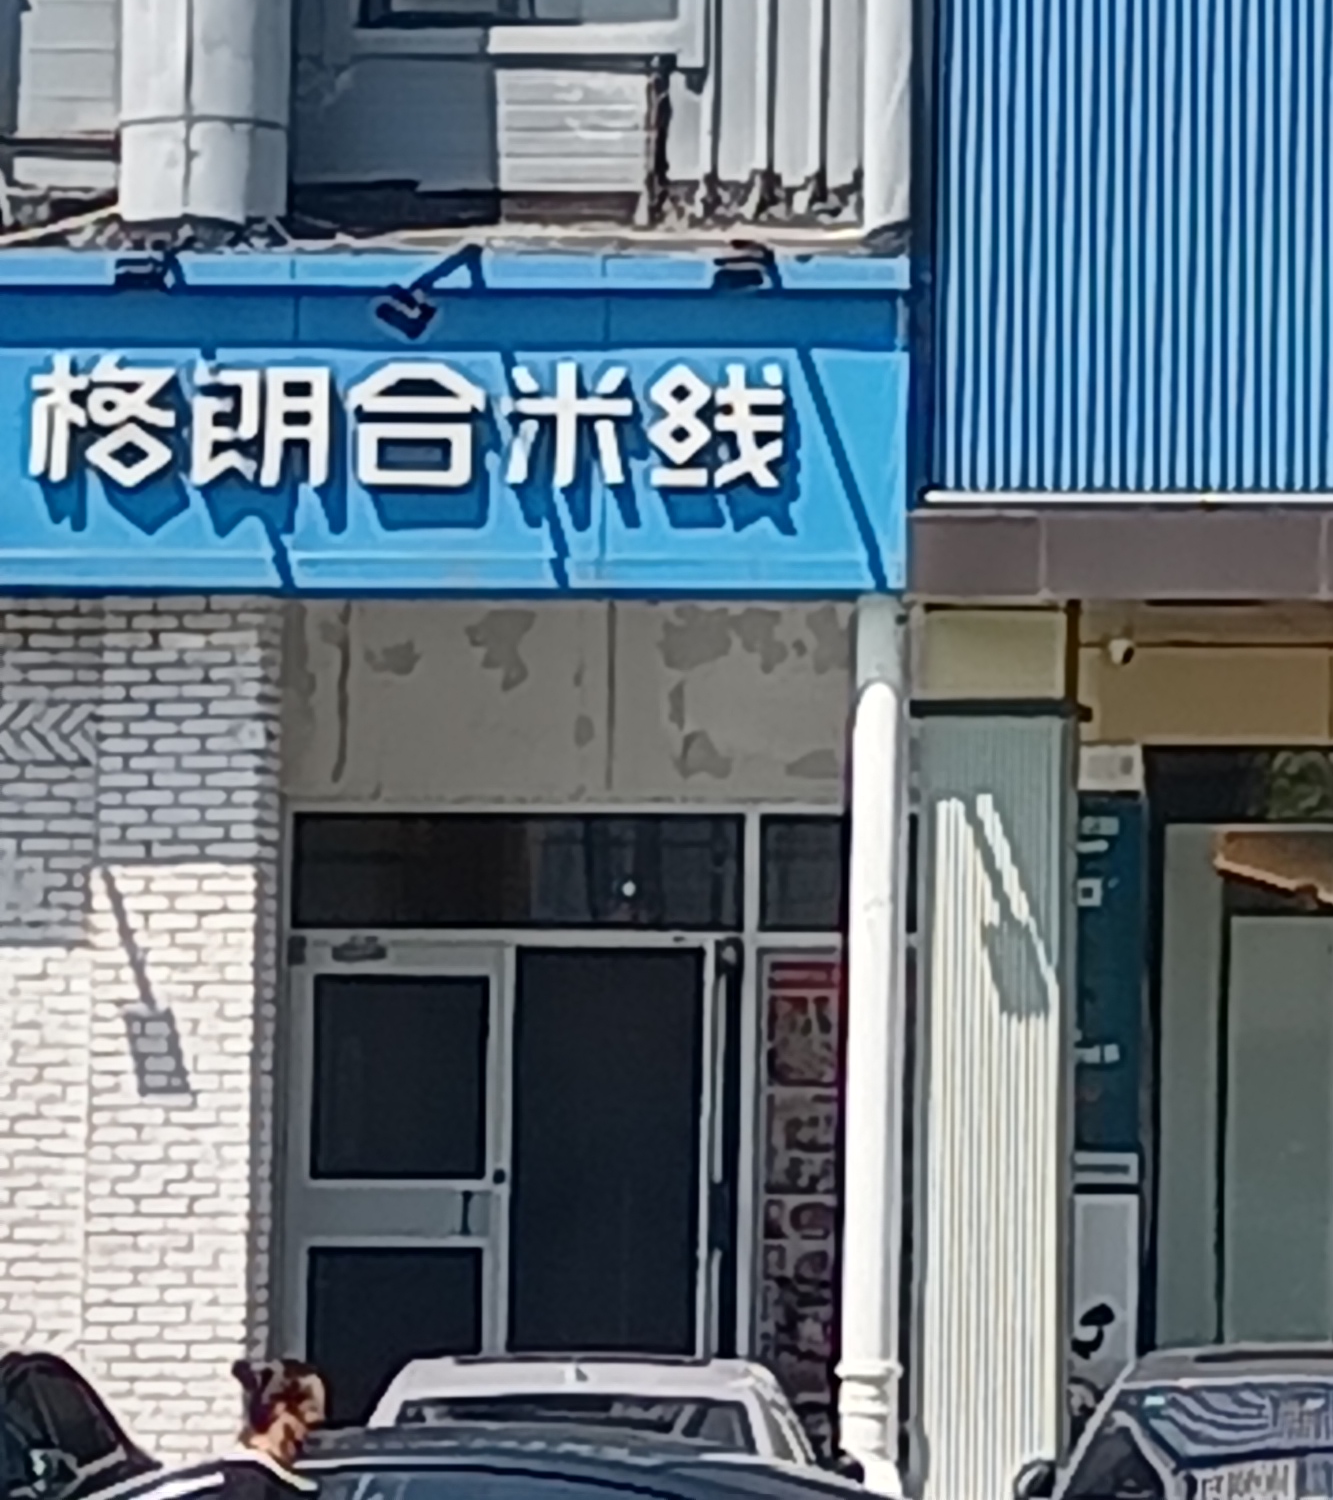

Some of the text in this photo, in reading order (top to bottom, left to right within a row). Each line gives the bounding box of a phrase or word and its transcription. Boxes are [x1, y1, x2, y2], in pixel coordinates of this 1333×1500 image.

[28, 351, 786, 488] 格朗合米线
